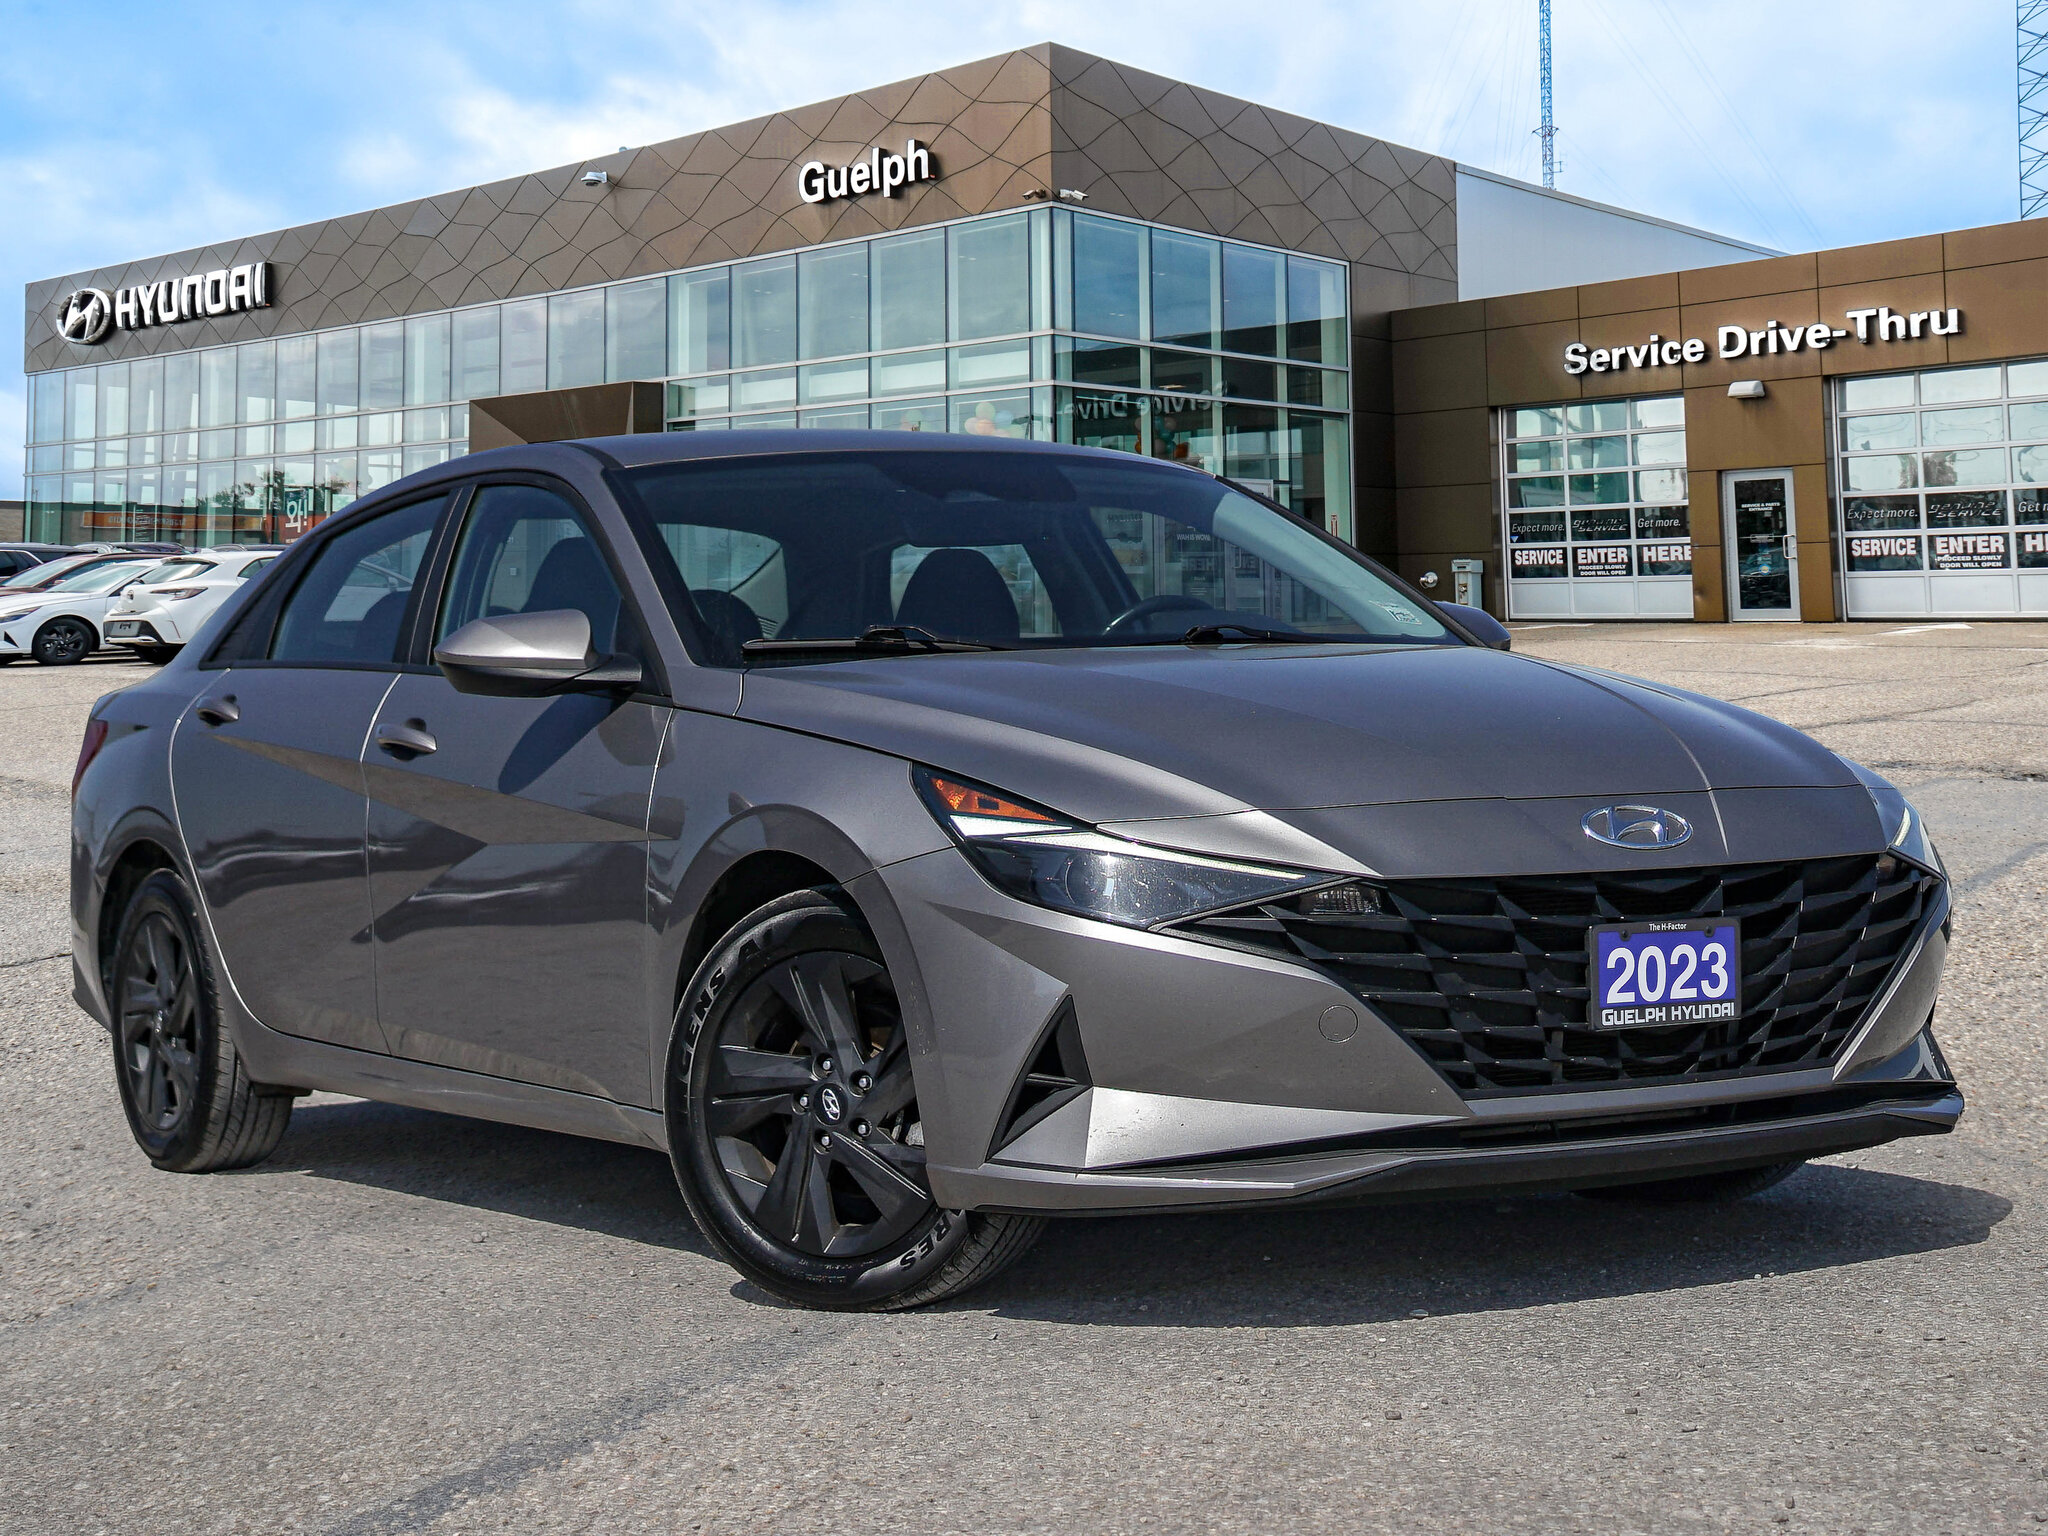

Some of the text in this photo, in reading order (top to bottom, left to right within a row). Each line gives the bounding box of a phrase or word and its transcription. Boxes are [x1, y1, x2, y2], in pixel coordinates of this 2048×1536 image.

[798, 138, 930, 204] Guelph
[114, 262, 269, 330] HYUNDAI
[1563, 306, 1961, 376] Service Drive-Thru
[1847, 508, 1918, 520] Expect more.
[2018, 501, 2040, 513] Get
[1511, 523, 1565, 535] Expect more.
[1637, 517, 1681, 528] Get more.
[1642, 544, 1692, 562] HERE
[1851, 538, 1917, 557] SERVICE
[1935, 535, 2005, 555] ENTER
[1514, 549, 1564, 566] SERVICE
[1576, 547, 1629, 564] ENTER
[1649, 922, 1687, 931] The H-Factor
[1606, 942, 1729, 1004] 2023
[1601, 1002, 1735, 1026] GUELPH HYUNDAI
